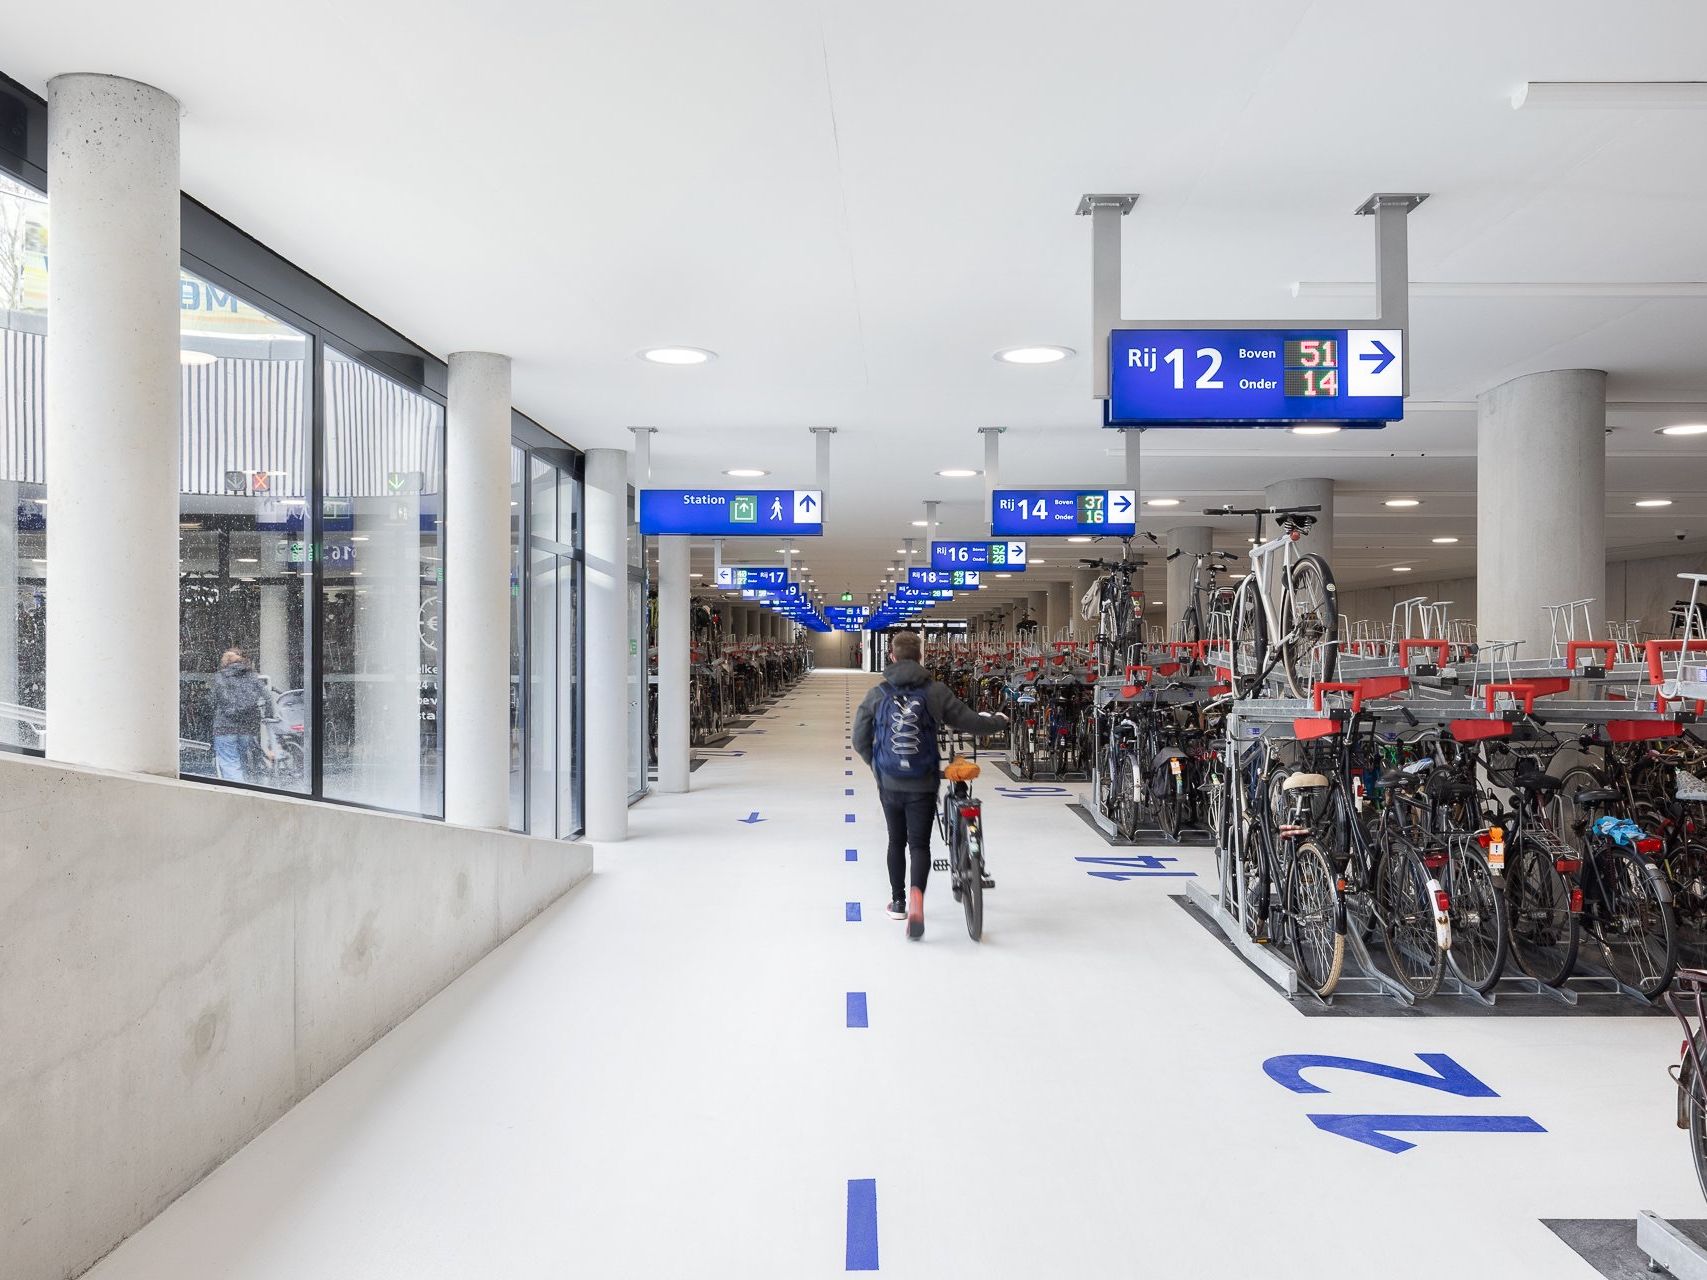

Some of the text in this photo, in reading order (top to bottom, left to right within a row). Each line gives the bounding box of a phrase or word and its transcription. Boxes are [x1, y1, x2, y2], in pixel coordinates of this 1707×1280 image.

[1239, 348, 1276, 359] Boven
[1301, 341, 1337, 367] 51
[1128, 348, 1224, 389] Rij 12
[1239, 378, 1276, 390] Onder
[1303, 370, 1338, 396] 14
[683, 494, 725, 505] Station
[1085, 496, 1104, 509] 37
[1000, 499, 1048, 520] Rij 14
[1086, 510, 1104, 523] 16
[936, 547, 968, 562] Rij 16
[992, 545, 1005, 554] 52
[769, 572, 784, 583] 17
[921, 572, 937, 583] 18
[1074, 855, 1199, 881] 14
[1262, 1053, 1549, 1154] 12
